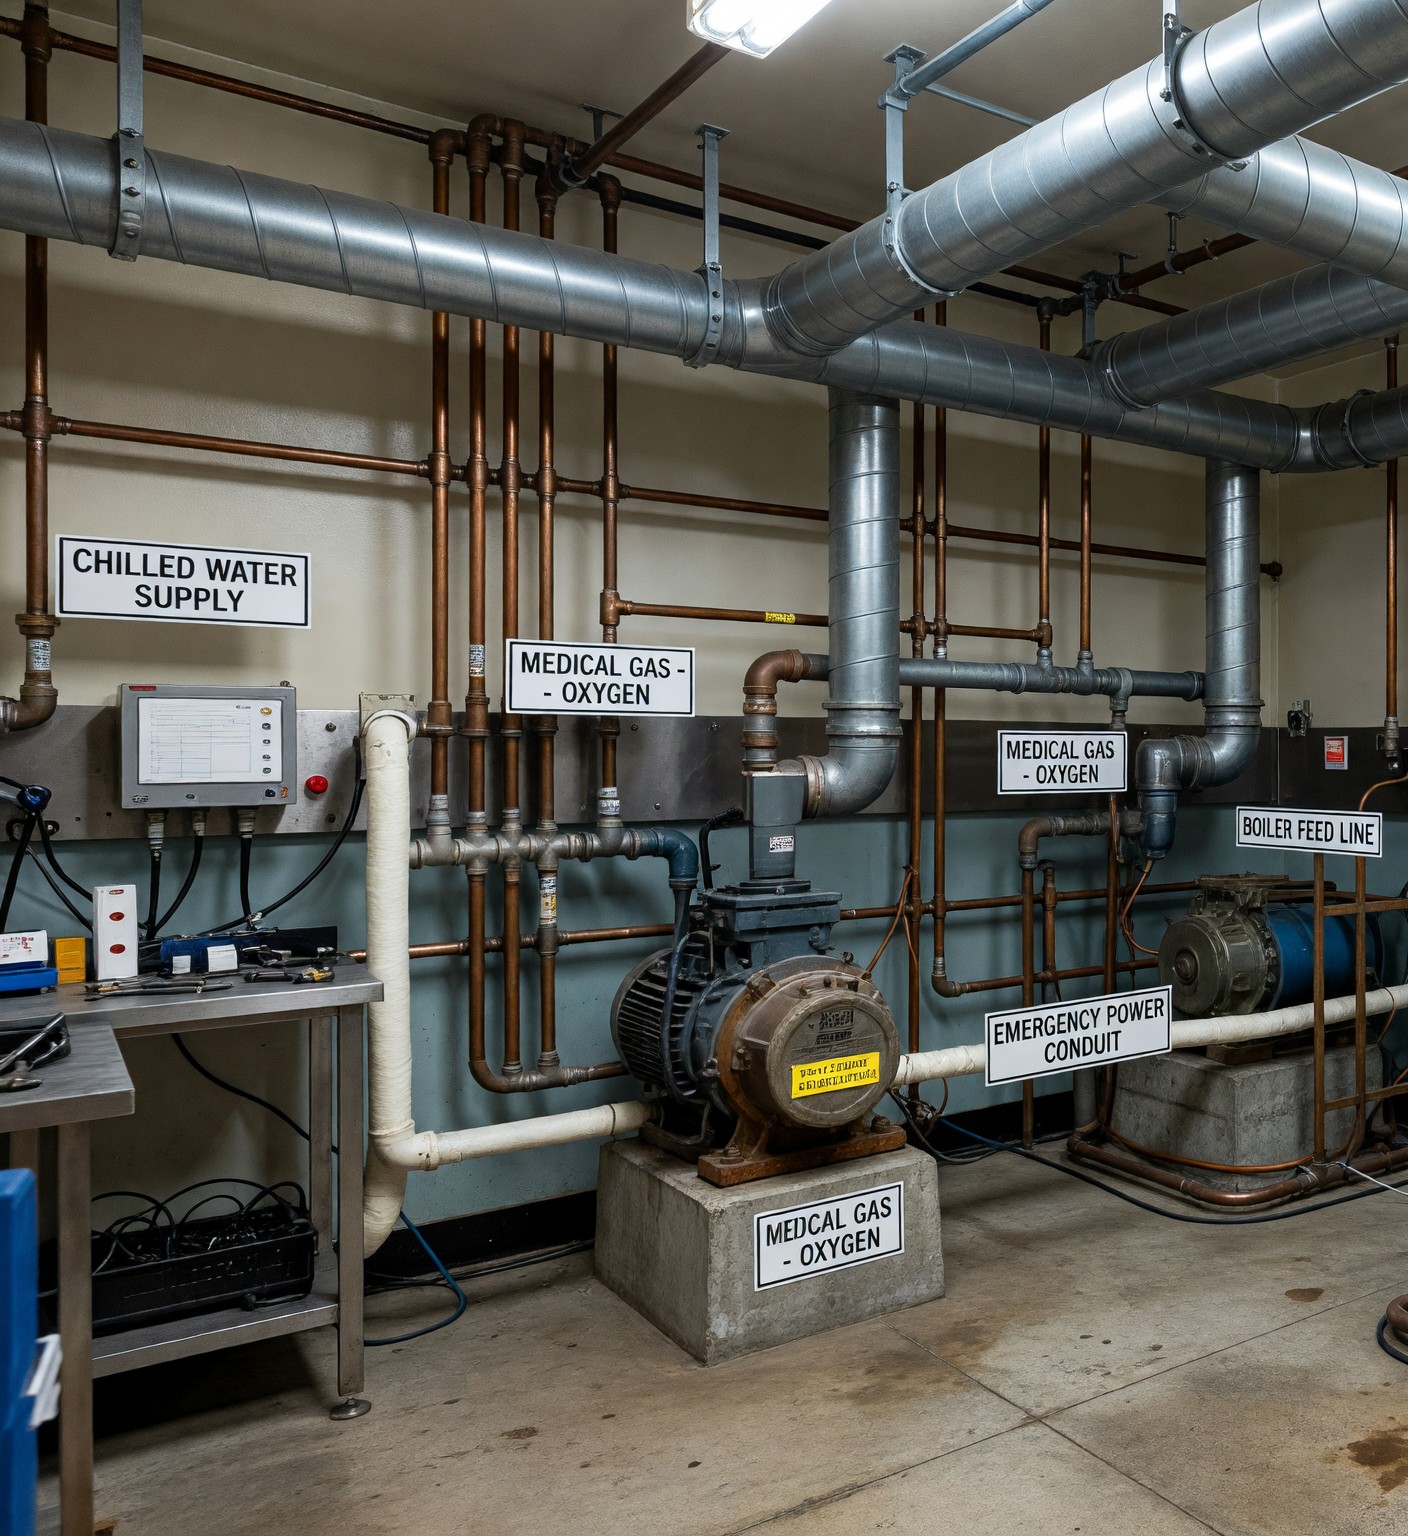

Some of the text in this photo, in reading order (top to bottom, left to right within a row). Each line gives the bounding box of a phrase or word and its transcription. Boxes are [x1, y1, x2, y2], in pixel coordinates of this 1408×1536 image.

[72, 548, 297, 587] CHILLED WATER
[134, 584, 245, 612] SUPPLY
[521, 652, 622, 677] MEDICAL
[629, 657, 671, 679] GAS
[562, 681, 650, 705] OXYGEN
[1006, 740, 1115, 760] MEDICAL GAS
[1036, 764, 1099, 784] OXYGEN
[1243, 816, 1375, 846] BOILER FEED LINE
[994, 997, 1165, 1045] EMERGENCY POWER
[1044, 1030, 1122, 1064] CONDUIT
[853, 1196, 892, 1225] GAS
[800, 1226, 880, 1266] OXYGEN
